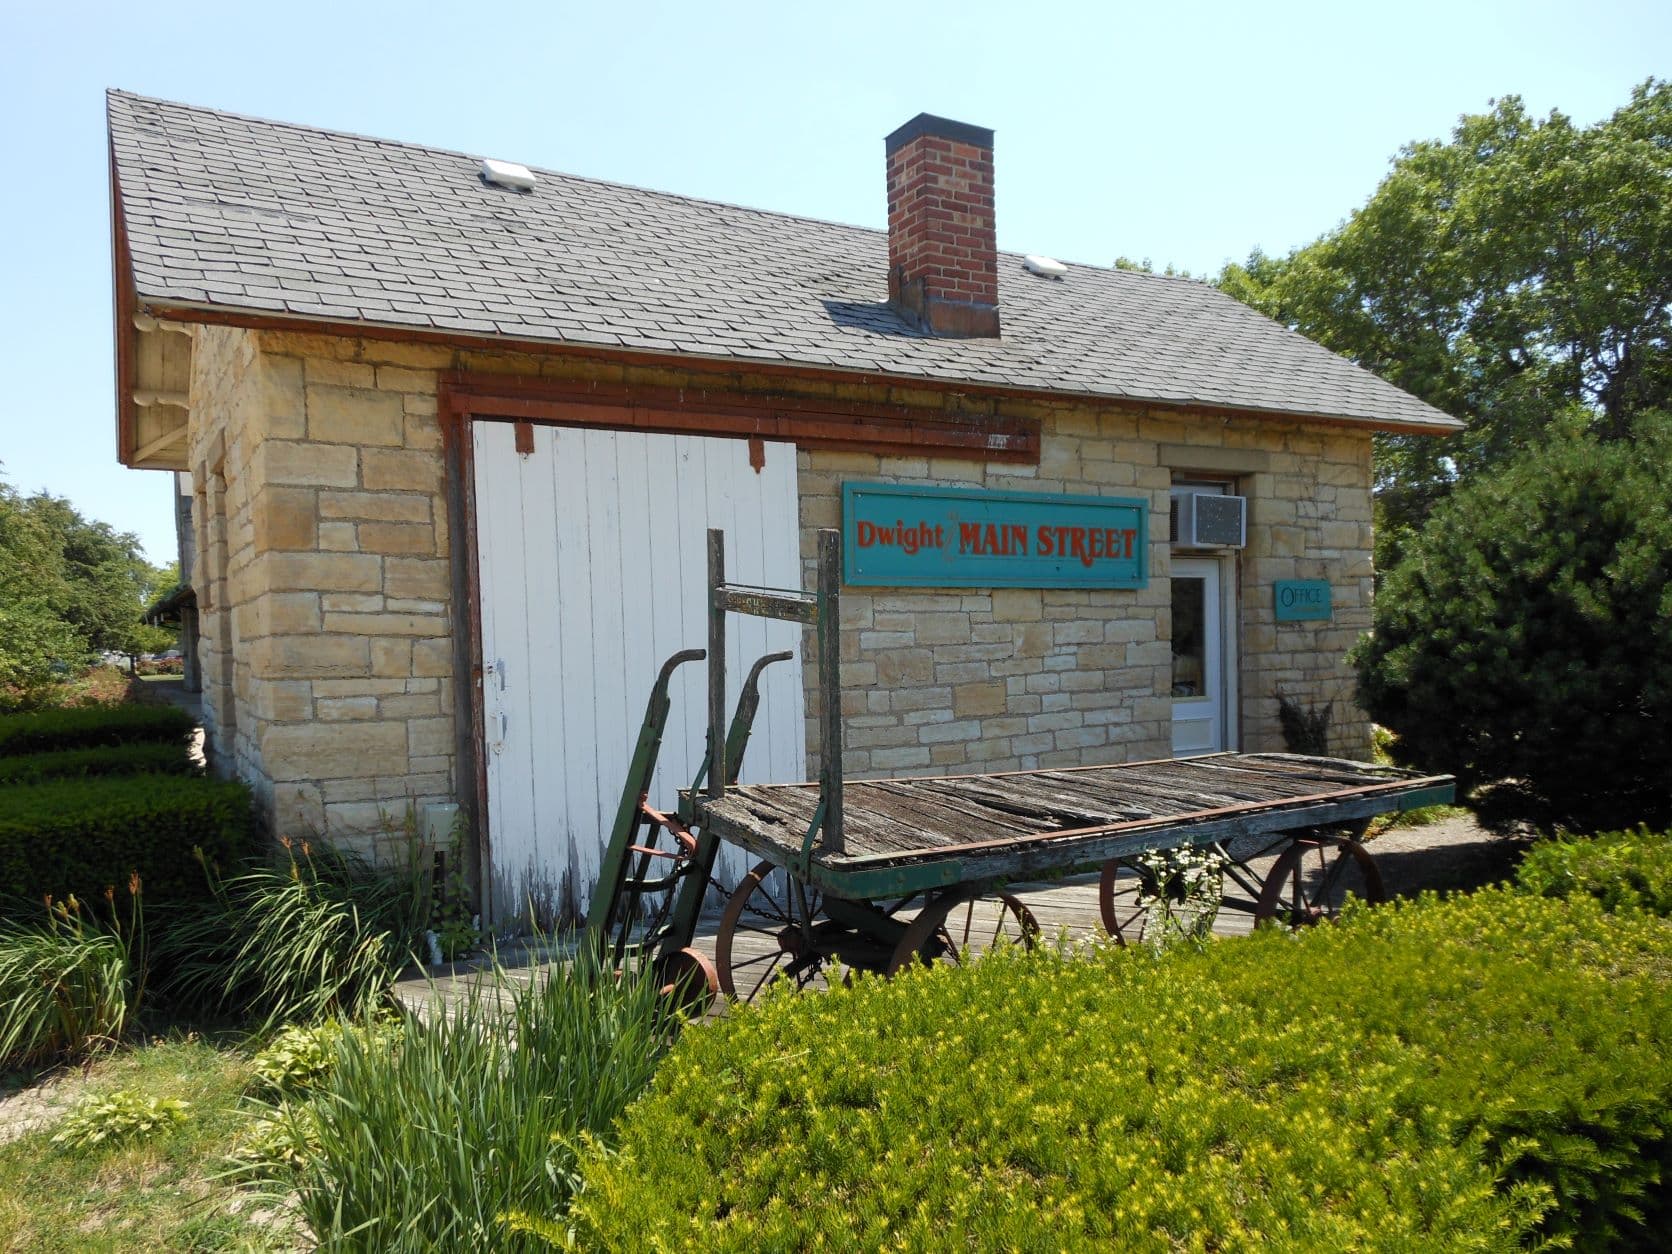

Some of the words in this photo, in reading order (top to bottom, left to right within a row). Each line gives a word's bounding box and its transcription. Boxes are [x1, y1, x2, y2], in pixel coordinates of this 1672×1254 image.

[857, 519, 944, 555] Dwight
[959, 522, 1028, 556] MAIN
[1036, 525, 1137, 568] STREET
[1280, 586, 1322, 608] OFFICE
